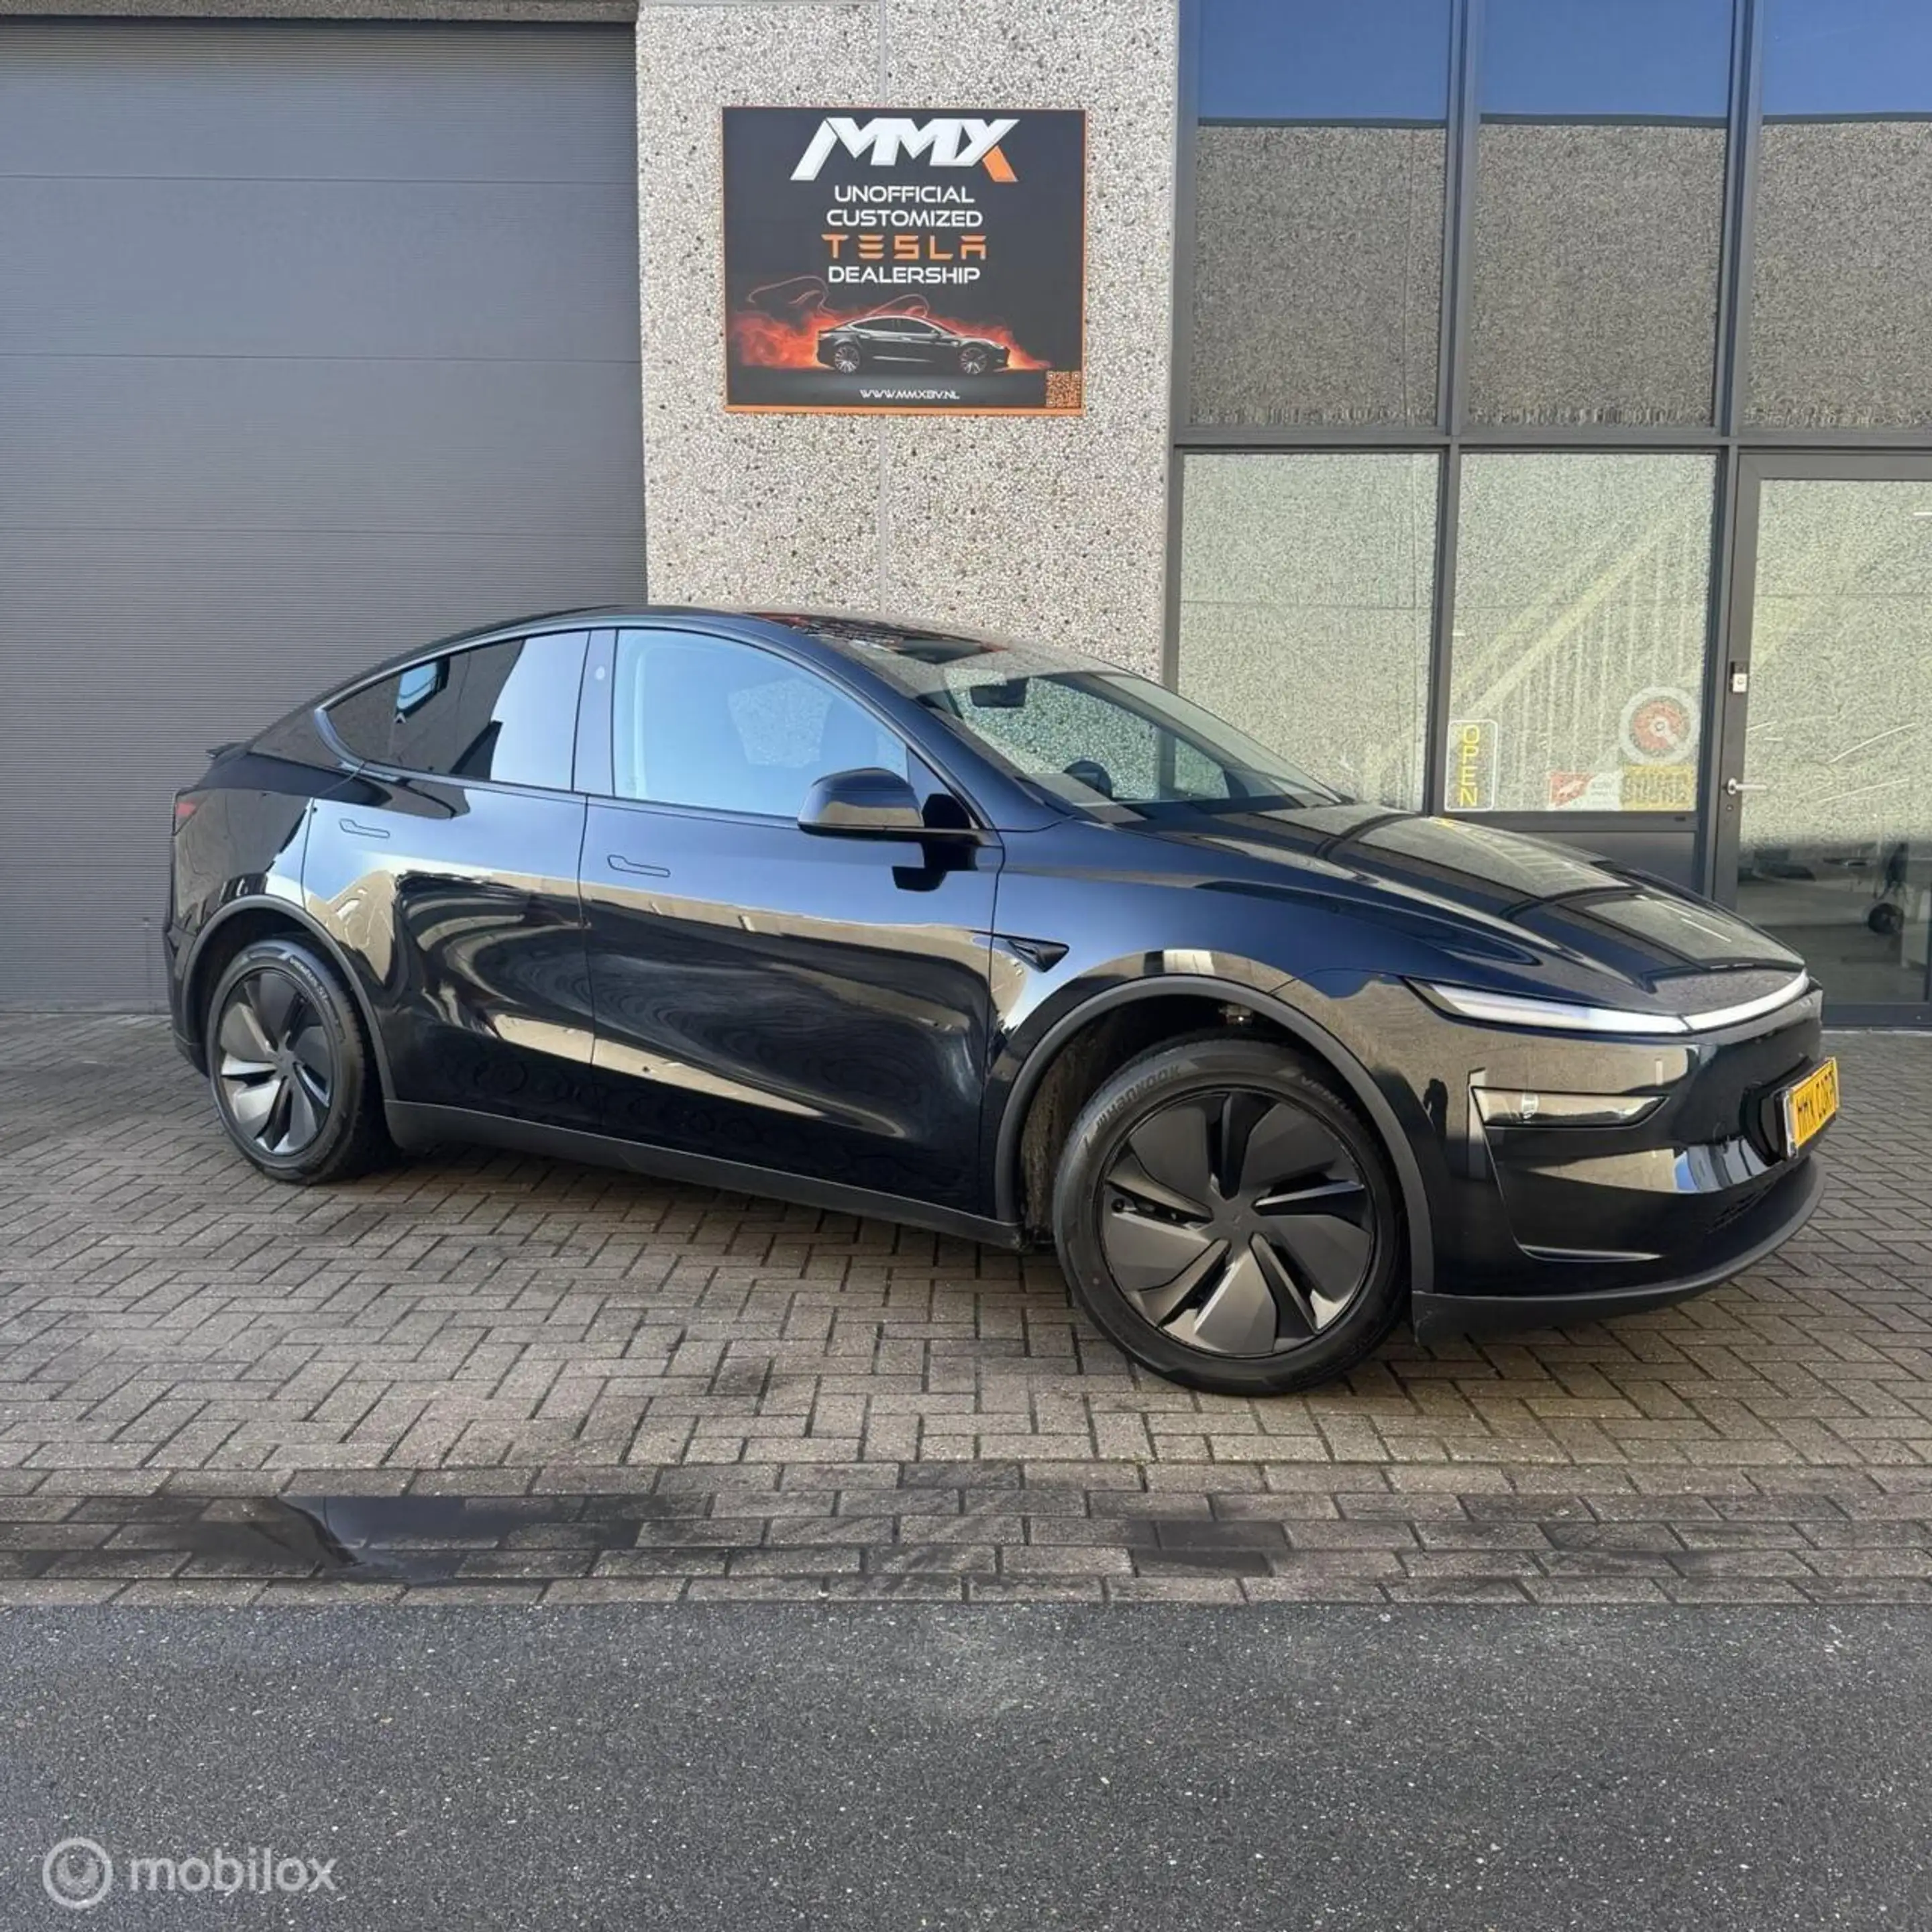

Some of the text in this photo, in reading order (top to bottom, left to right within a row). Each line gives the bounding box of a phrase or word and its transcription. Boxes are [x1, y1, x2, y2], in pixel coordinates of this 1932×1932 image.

[790, 117, 1020, 182] MMX
[834, 185, 975, 203] UNOFFICIAL
[826, 209, 983, 227] CUSTOMIZED
[821, 234, 987, 260] TESLA
[828, 266, 981, 284] DEALERSHIP
[1460, 724, 1480, 808] OPEN
